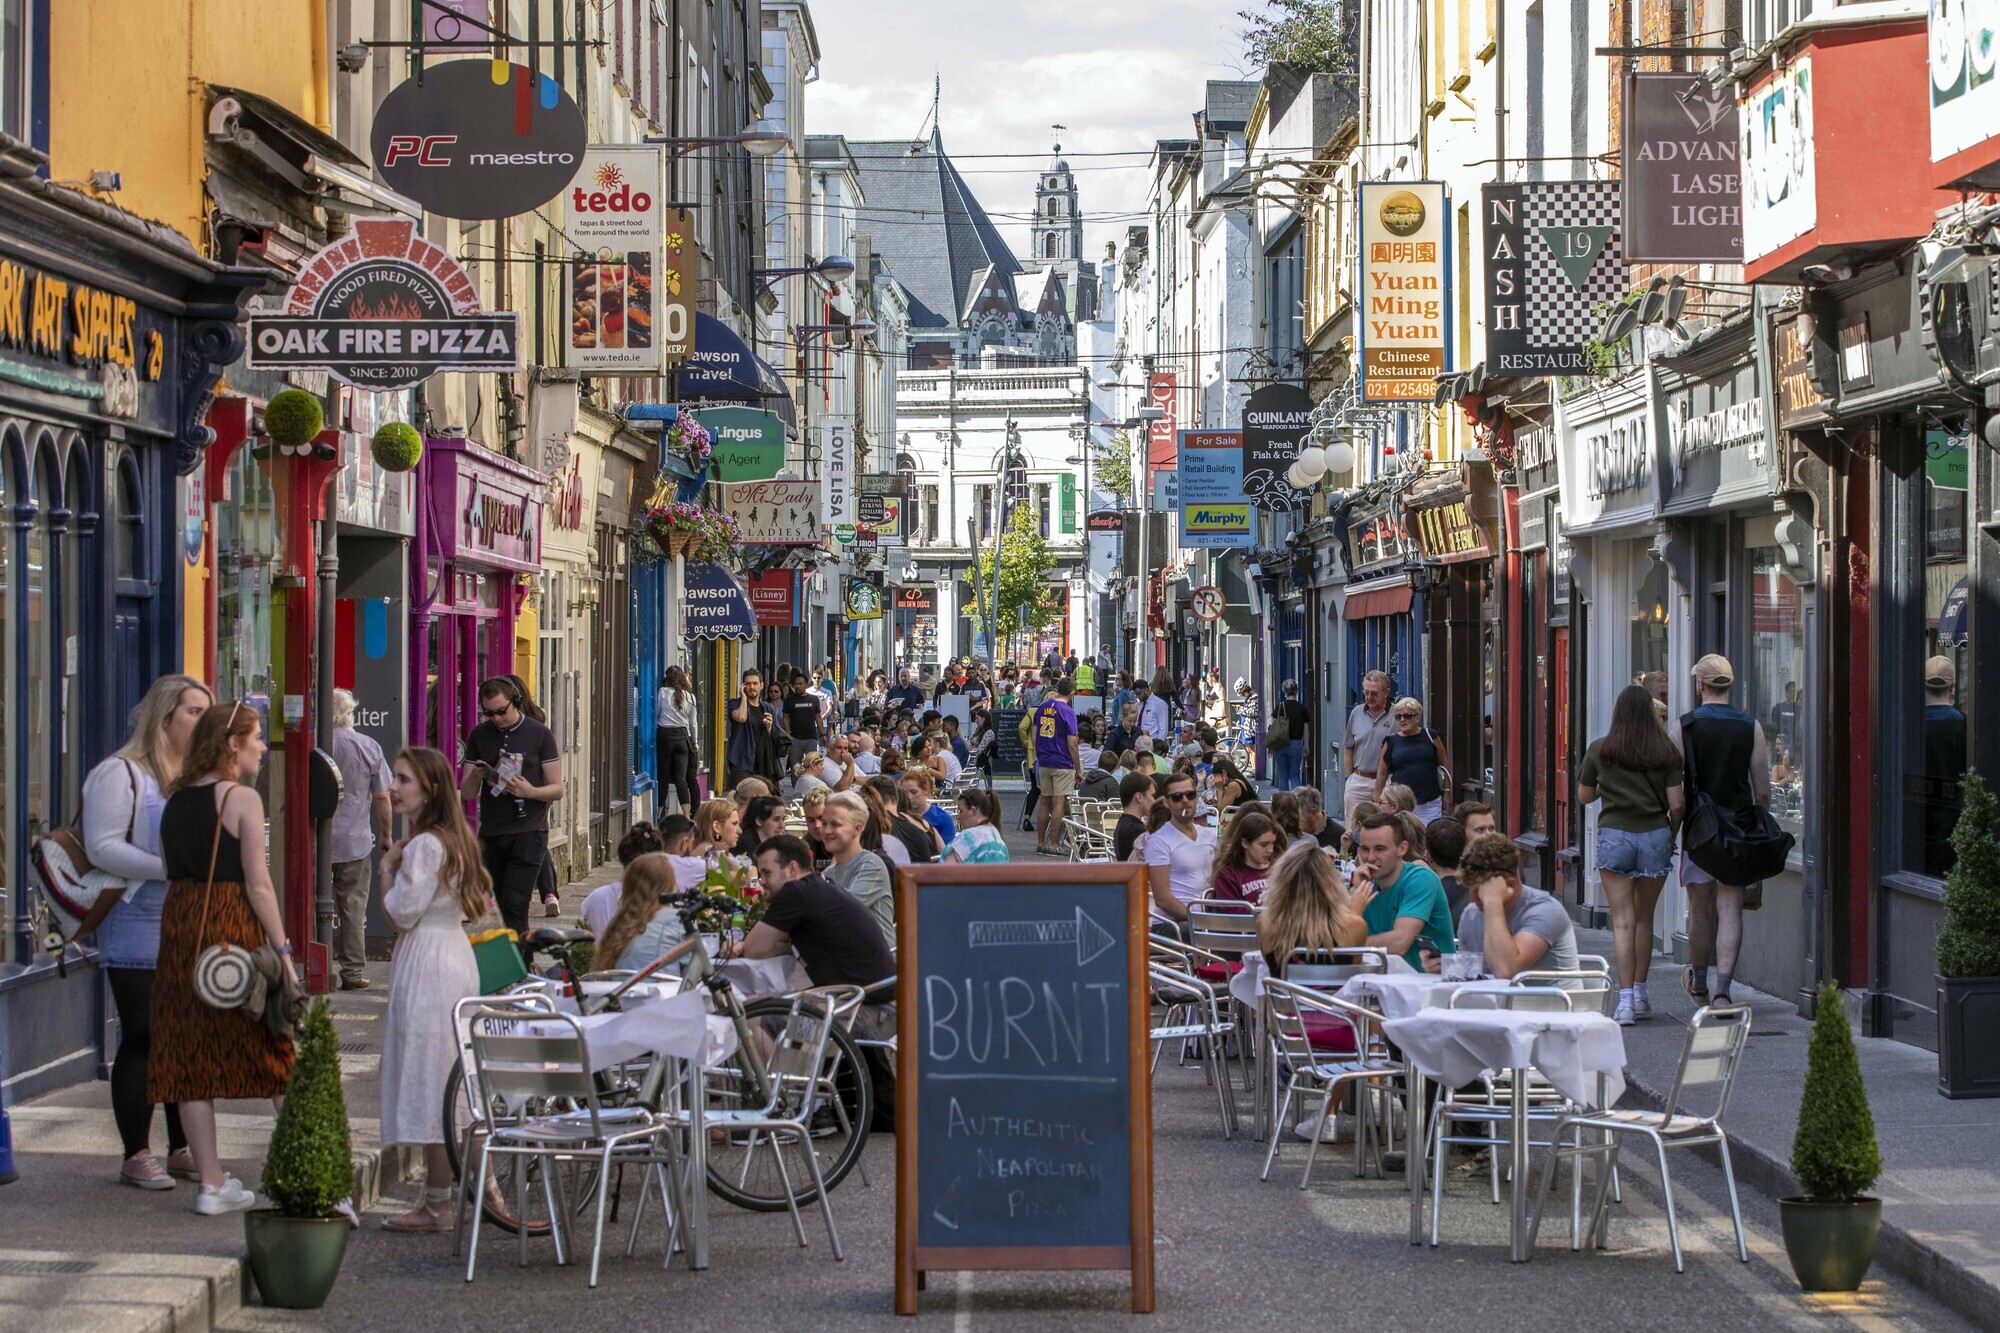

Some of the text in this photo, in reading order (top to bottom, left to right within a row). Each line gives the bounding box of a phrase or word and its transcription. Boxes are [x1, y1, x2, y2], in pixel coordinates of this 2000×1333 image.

[384, 135, 574, 167] PC maestro
[572, 184, 651, 213] tedo
[580, 221, 598, 229] tapas
[1370, 241, 1437, 264] 圓明園
[1561, 232, 1593, 258] 19
[1490, 199, 1521, 331] NASH
[1370, 271, 1438, 290] Yuan
[329, 270, 437, 311] WOOD FIRED PIZZA
[1371, 296, 1439, 319] Ming
[0, 259, 164, 380] RK ART SUPPLIES 29
[1371, 321, 1439, 339] Yuan
[257, 328, 510, 355] OAK FIRE PIZZA
[583, 353, 641, 362] www.tedo.ie
[691, 351, 740, 362] awson
[1378, 351, 1431, 364] Chinese
[350, 366, 418, 379] SINCE: 2010
[1368, 364, 1442, 377] Restaurant
[1367, 383, 1390, 397] 021
[1196, 436, 1237, 446] For Sale
[1268, 440, 1293, 449] Fresh
[728, 453, 761, 466] Agent
[1184, 455, 1205, 464] Prime
[1253, 450, 1271, 459] Fish
[1273, 451, 1280, 459] &
[830, 426, 844, 518] LOVE LISA
[1184, 465, 1236, 475] Retail Building
[1193, 510, 1246, 526] Murphy
[748, 528, 801, 537] LADIES
[755, 590, 784, 601] Lisney
[916, 600, 930, 608] DISCS
[694, 625, 708, 634] 021
[710, 625, 743, 633] 4274397
[1039, 716, 1056, 738] 23
[925, 974, 1120, 1067] BURNT
[948, 1096, 1095, 1146] AUTHENTIC
[976, 1147, 1103, 1180] NEAPOLITAN
